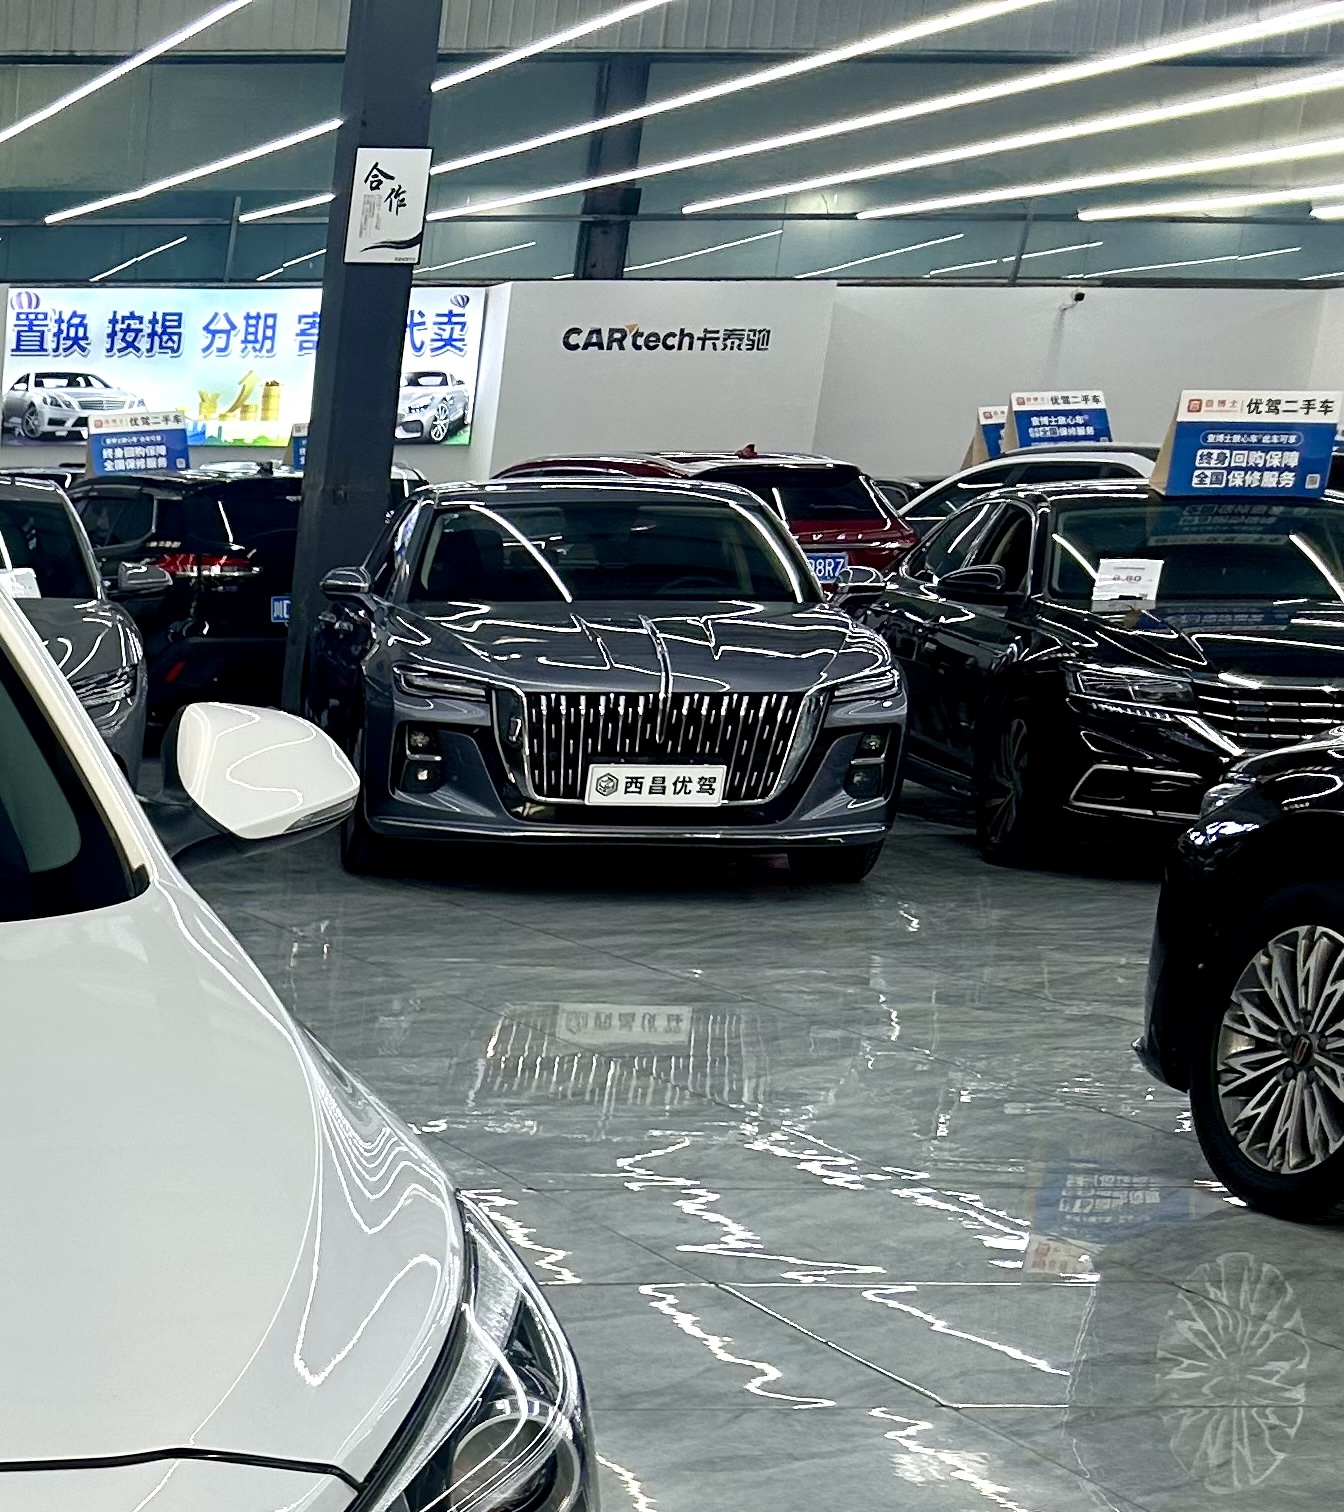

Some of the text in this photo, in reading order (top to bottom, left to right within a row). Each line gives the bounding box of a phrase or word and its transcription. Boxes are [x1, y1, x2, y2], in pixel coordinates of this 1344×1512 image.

[364, 162, 407, 216] 合作
[12, 312, 89, 354] 置换
[106, 311, 183, 354] 按揭
[201, 312, 276, 354] 分期
[1246, 398, 1335, 416] 优驾二手车
[1197, 450, 1300, 468] 终身回购保障
[1193, 471, 1297, 489] 全国保修服务
[624, 775, 717, 796] 西昌优驾
